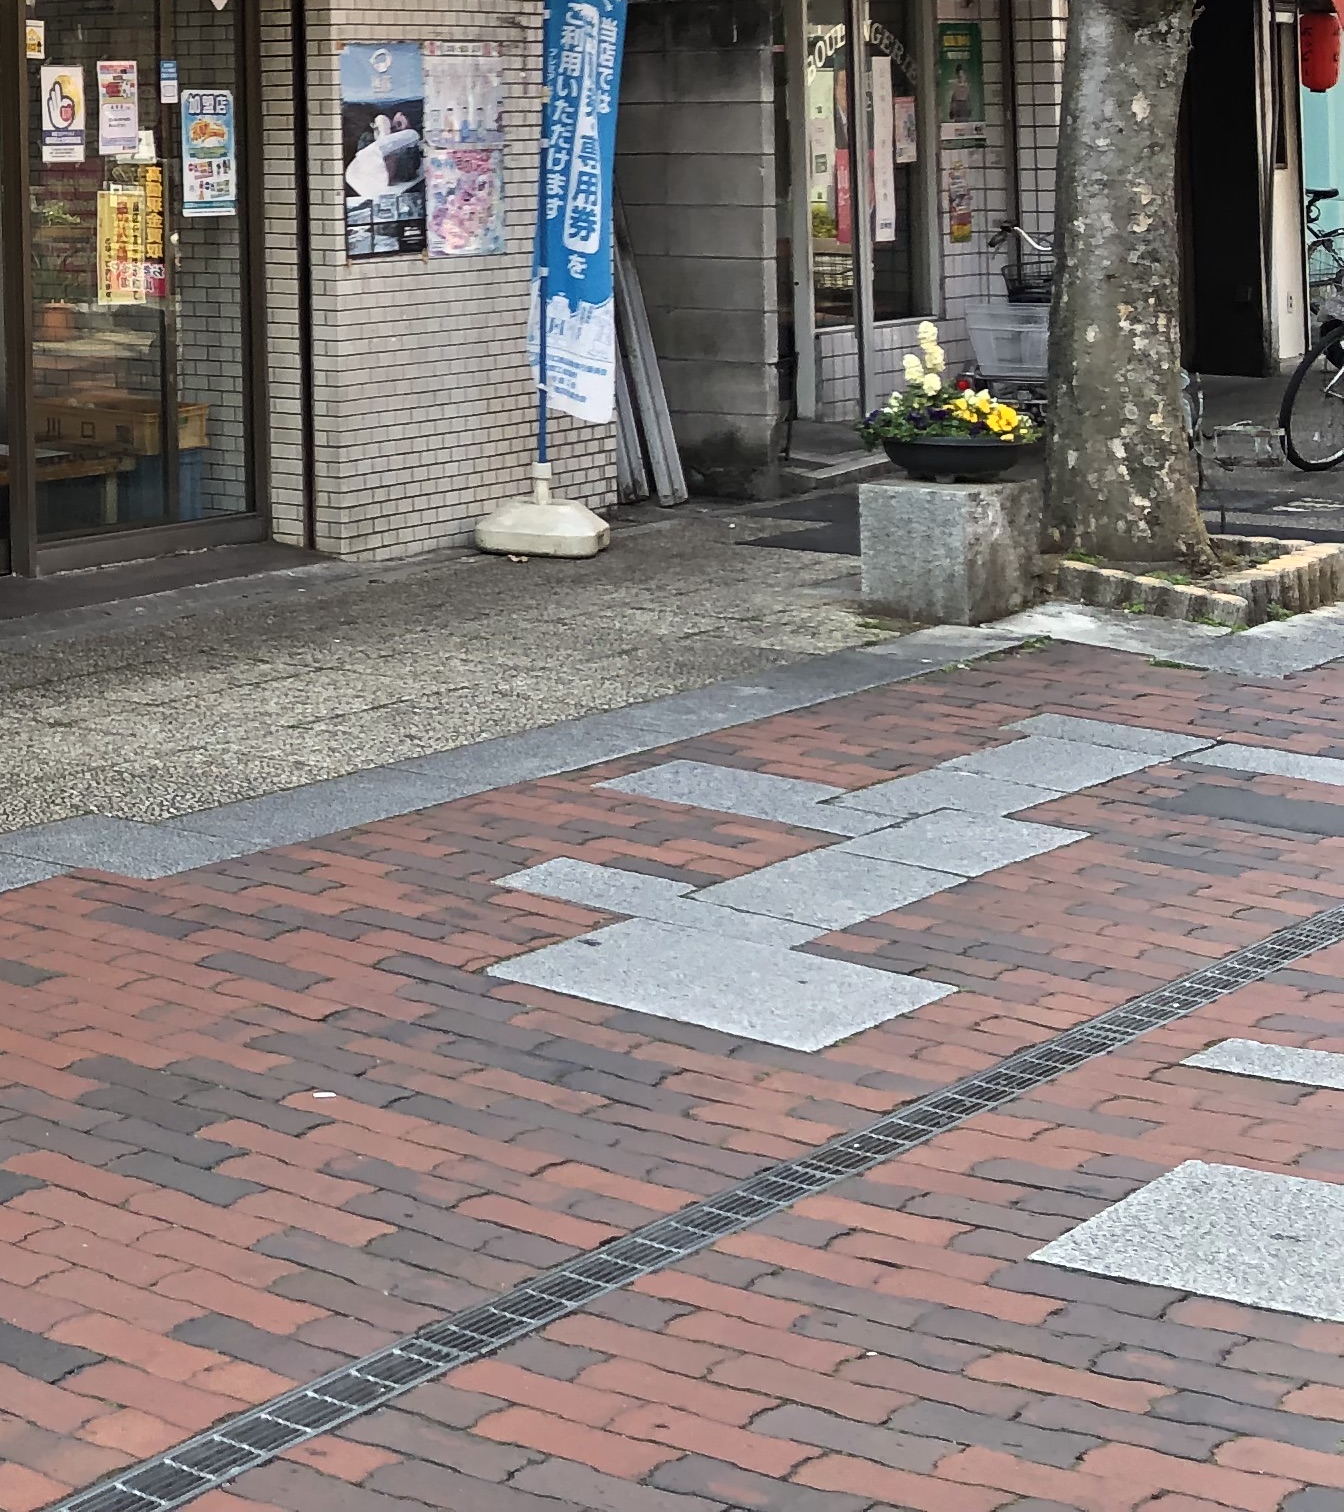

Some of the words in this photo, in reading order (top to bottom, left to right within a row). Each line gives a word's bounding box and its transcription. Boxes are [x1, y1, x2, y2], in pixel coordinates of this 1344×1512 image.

[188, 92, 229, 116] 加盟店
[545, 1, 586, 220] ご利用いただけます
[597, 16, 618, 114] 当店では
